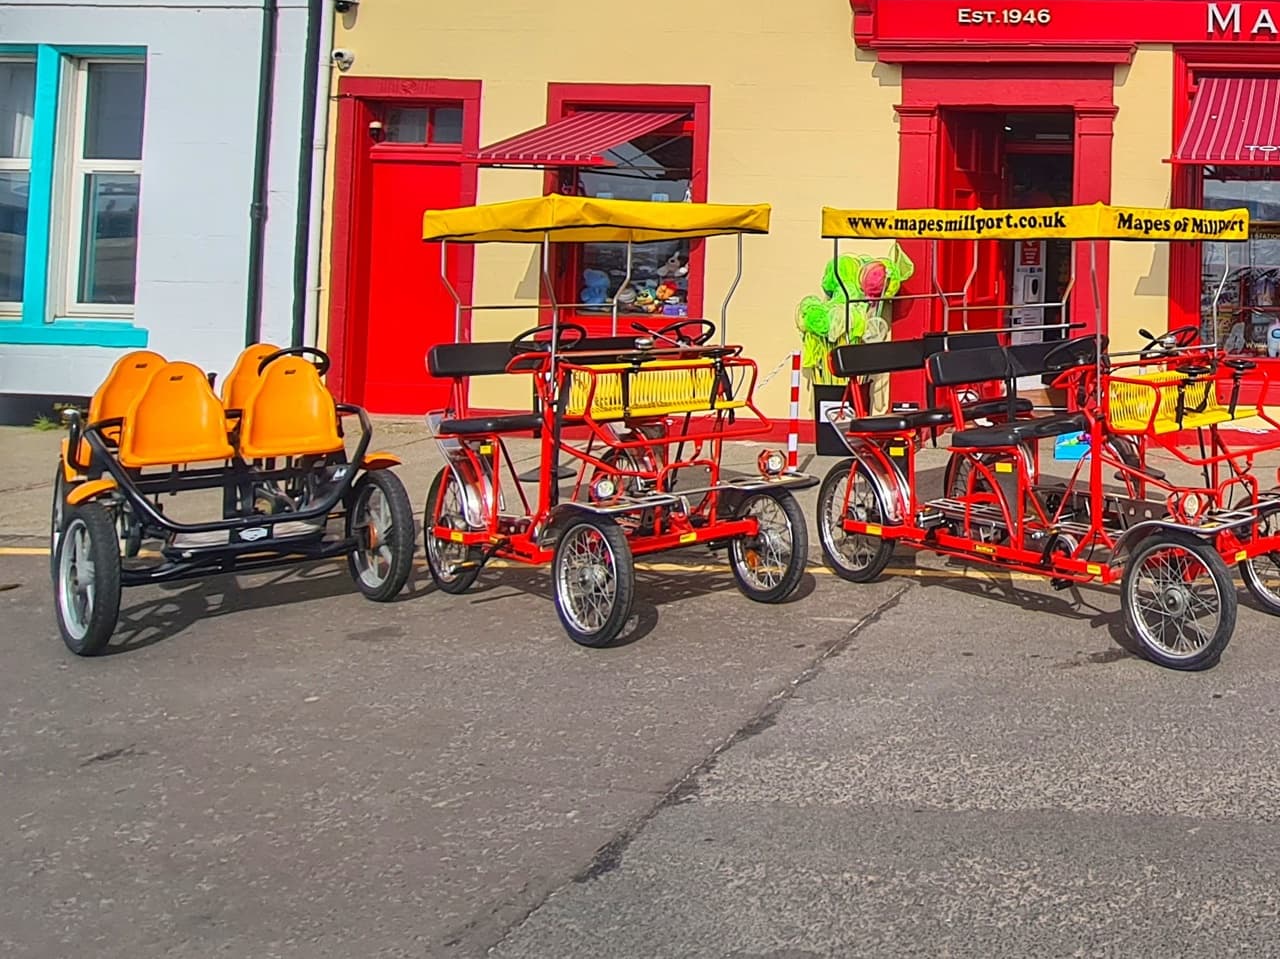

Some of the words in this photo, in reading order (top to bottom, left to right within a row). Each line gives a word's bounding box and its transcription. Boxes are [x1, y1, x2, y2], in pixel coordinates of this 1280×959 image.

[848, 211, 1066, 234] www.mapesmillport.co.uk
[1117, 212, 1171, 234] Mapes
[1173, 217, 1189, 232] of
[1191, 217, 1244, 235] Millport
